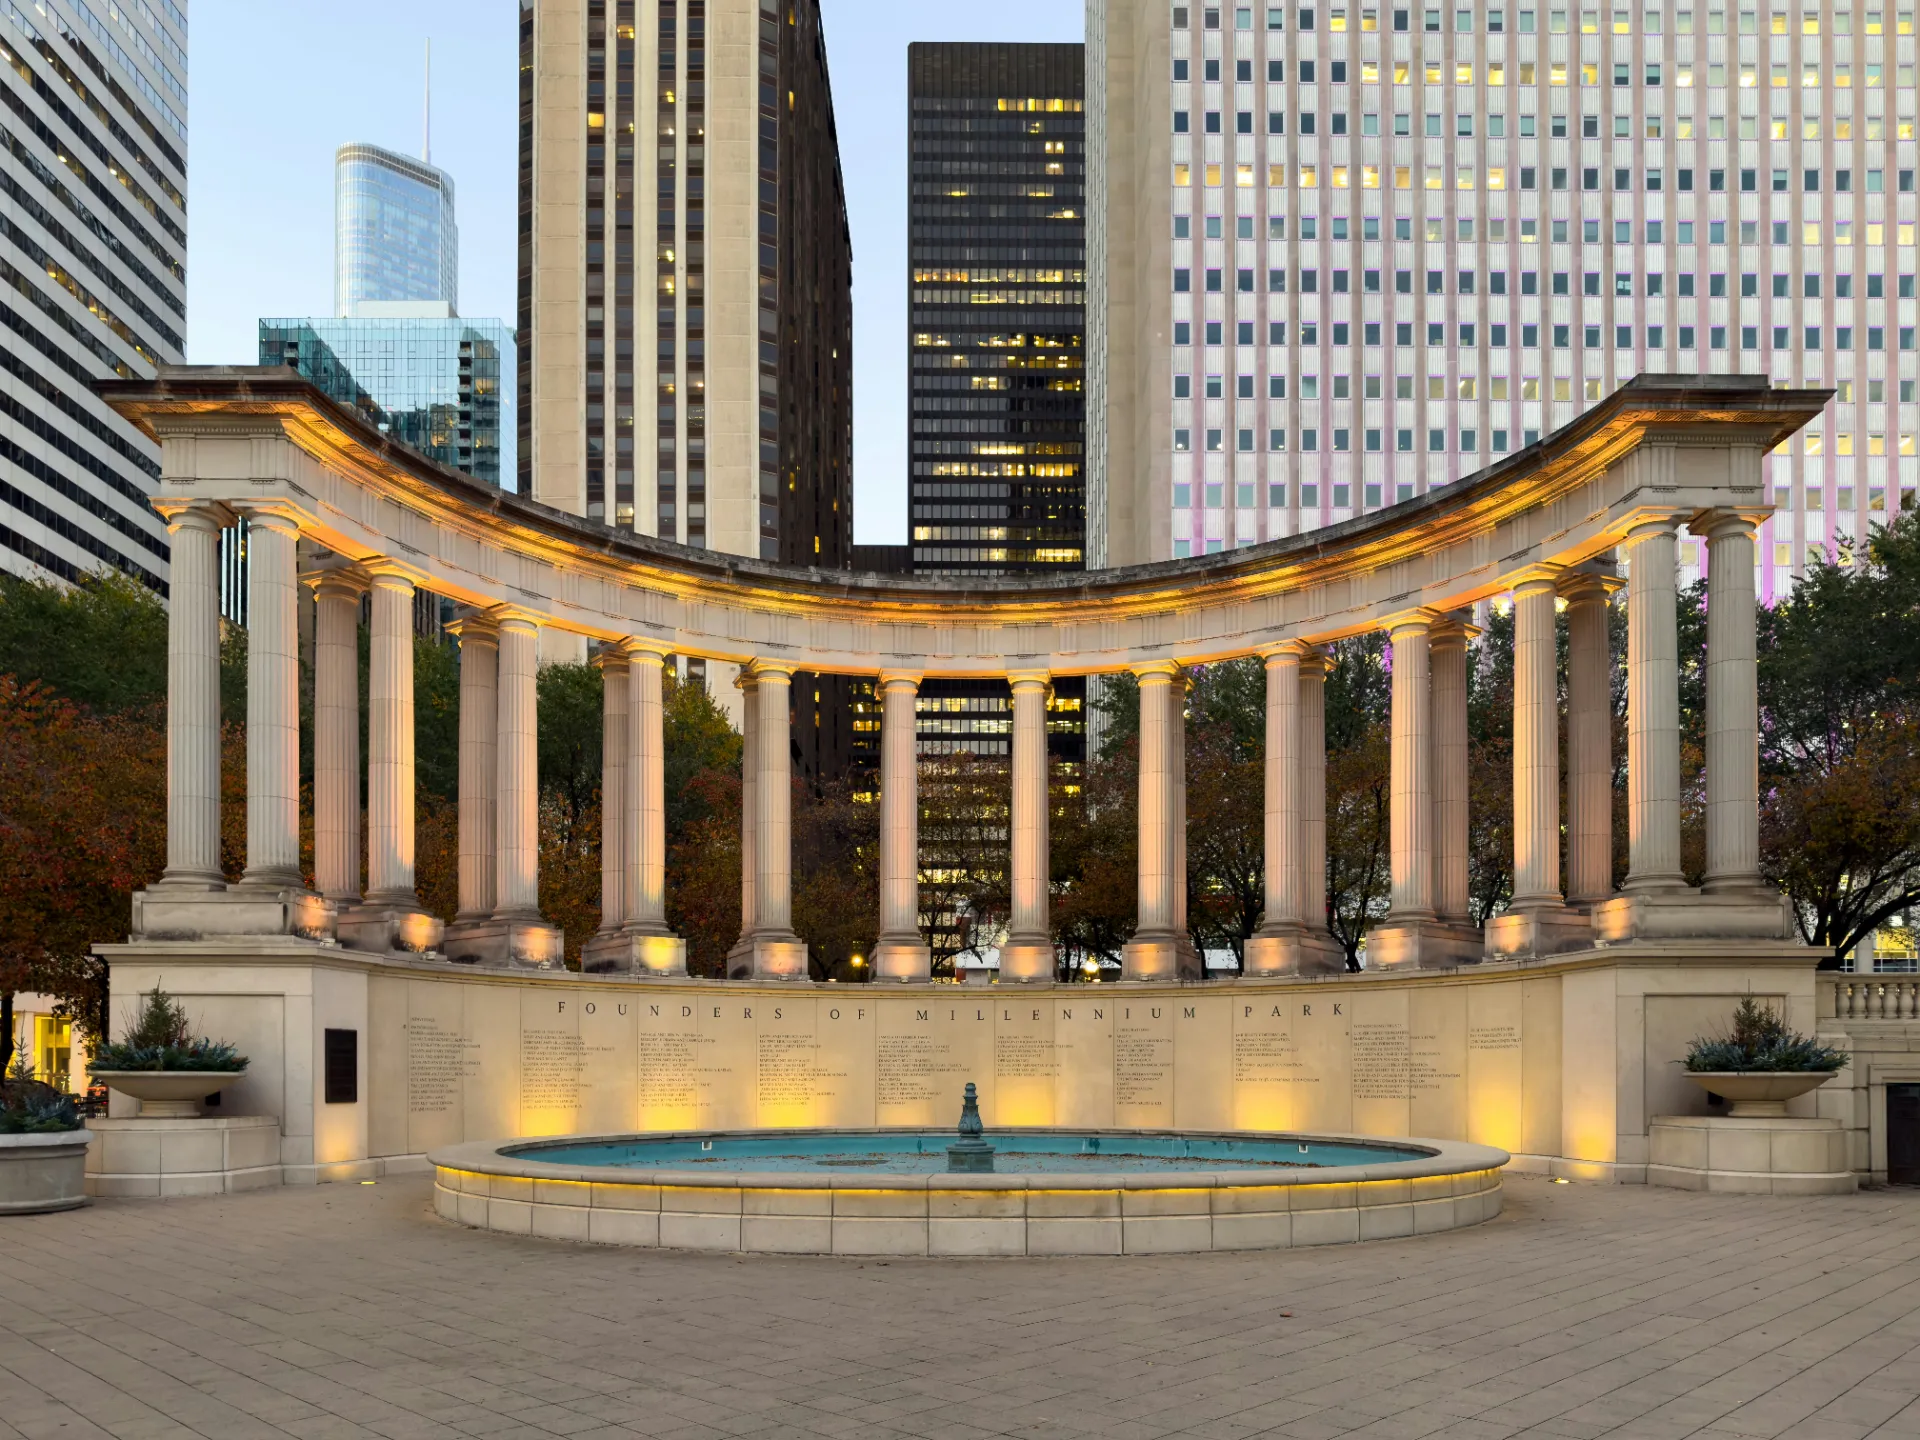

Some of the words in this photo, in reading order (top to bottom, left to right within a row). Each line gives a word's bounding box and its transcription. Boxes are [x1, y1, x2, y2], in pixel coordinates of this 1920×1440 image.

[557, 1001, 783, 1019] FOUNDERS
[829, 1008, 865, 1020] OF
[916, 1007, 1196, 1021] MILLENNIUM
[1244, 1003, 1342, 1017] PARK
